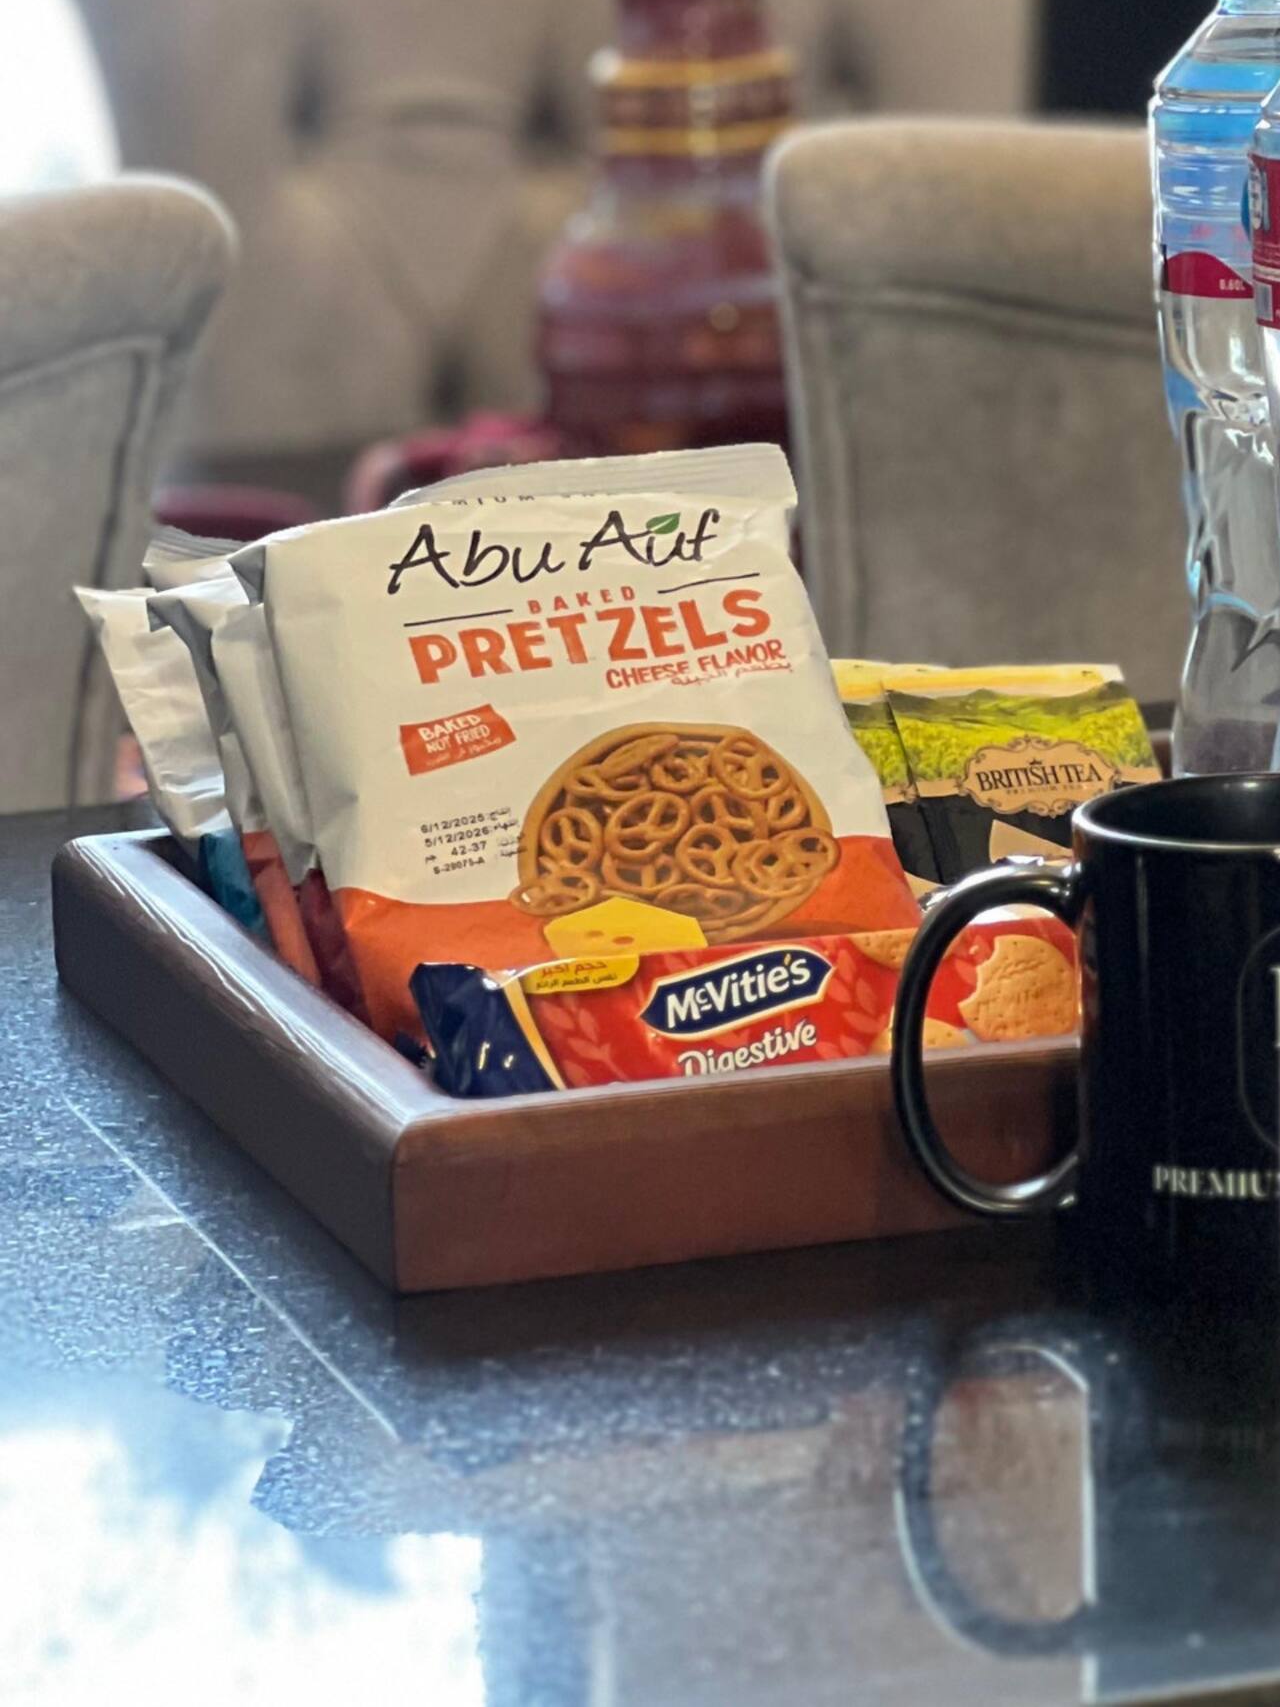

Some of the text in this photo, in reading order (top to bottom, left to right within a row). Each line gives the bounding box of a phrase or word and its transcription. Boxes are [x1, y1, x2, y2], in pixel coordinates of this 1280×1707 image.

[387, 524, 565, 594] Abu
[527, 586, 636, 615] BAKED
[408, 589, 771, 684] PRETZELS
[606, 639, 786, 689] CHEESE FLAVOR
[418, 714, 481, 741] BAKED
[425, 737, 452, 754] NOT
[454, 724, 491, 746] FRIED
[976, 765, 1060, 792] BRITISH
[1060, 762, 1103, 783] TEA
[666, 953, 811, 1029] McVitie's
